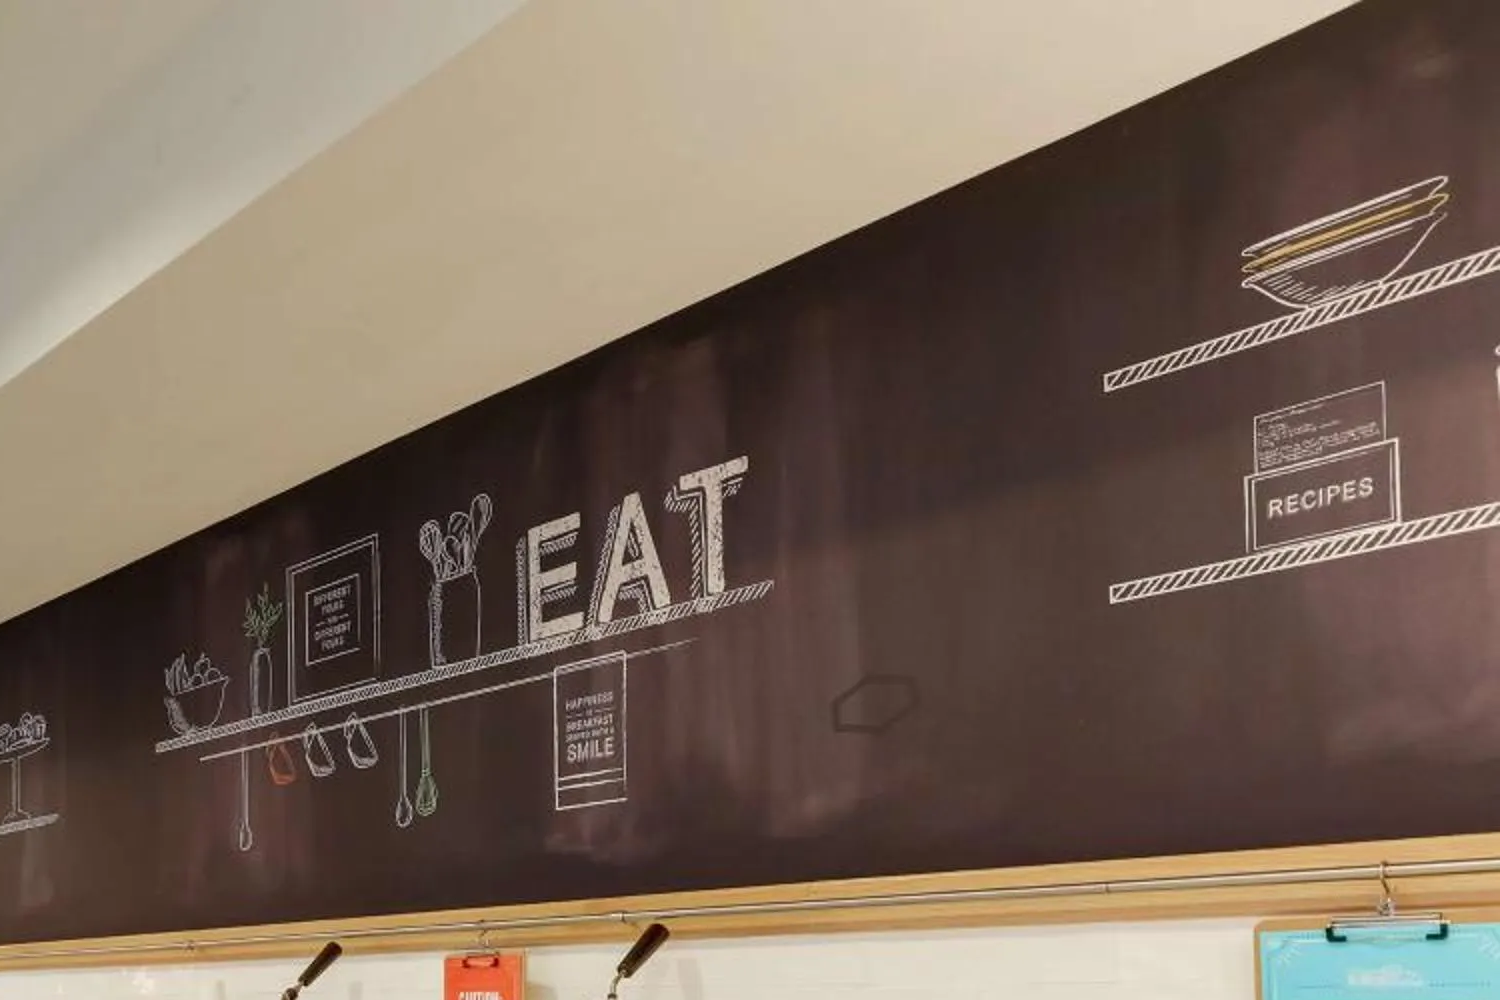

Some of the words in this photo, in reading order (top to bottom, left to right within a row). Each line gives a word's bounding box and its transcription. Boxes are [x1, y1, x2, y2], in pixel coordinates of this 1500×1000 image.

[1268, 477, 1374, 519] RECIPES
[522, 455, 749, 643] EAT
[566, 692, 613, 711] HAPPINESS
[565, 713, 613, 733] BREAKFAST
[566, 736, 615, 763] SMILE
